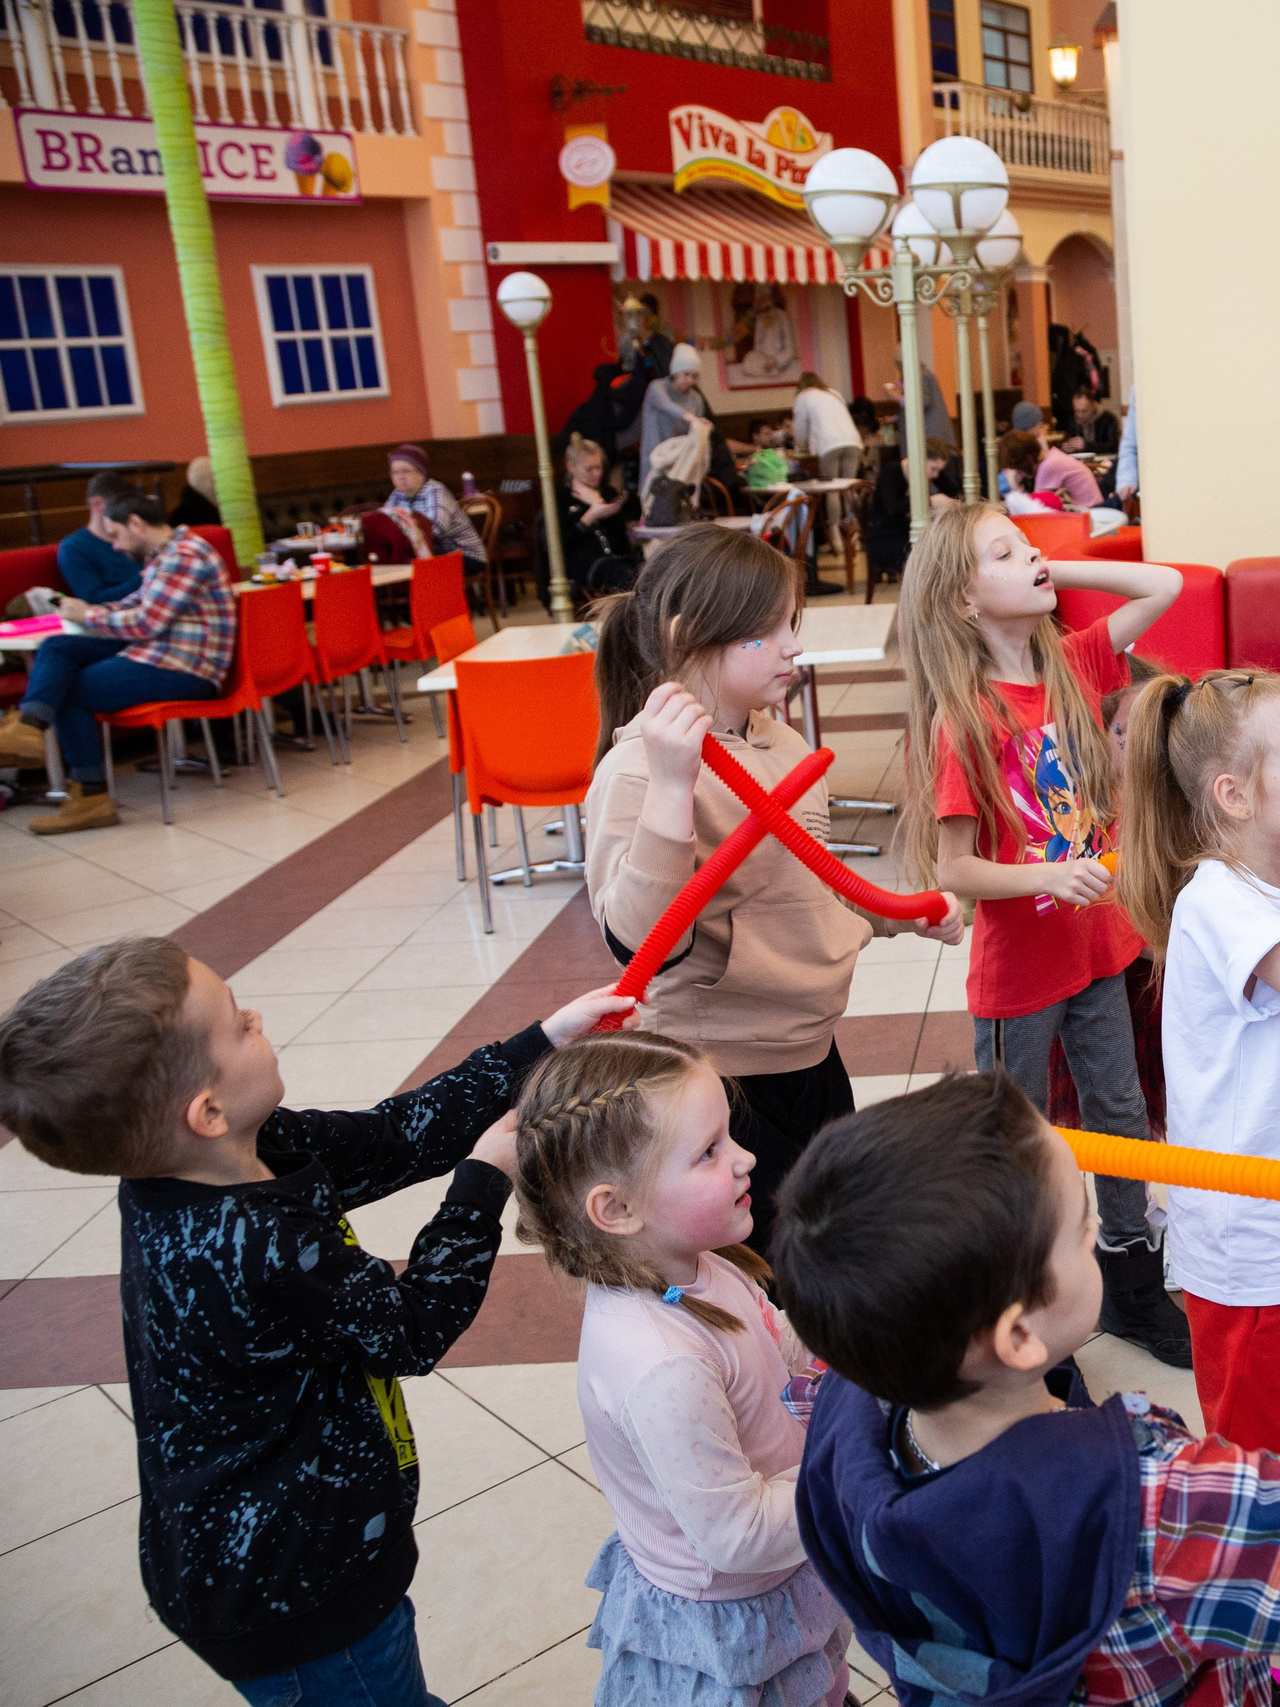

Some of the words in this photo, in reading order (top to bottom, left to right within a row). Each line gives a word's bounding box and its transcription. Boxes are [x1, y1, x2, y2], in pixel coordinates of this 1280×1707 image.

[35, 128, 163, 176] BRan
[197, 140, 277, 181] ICE
[673, 111, 738, 155] Viva
[745, 135, 767, 171] la
